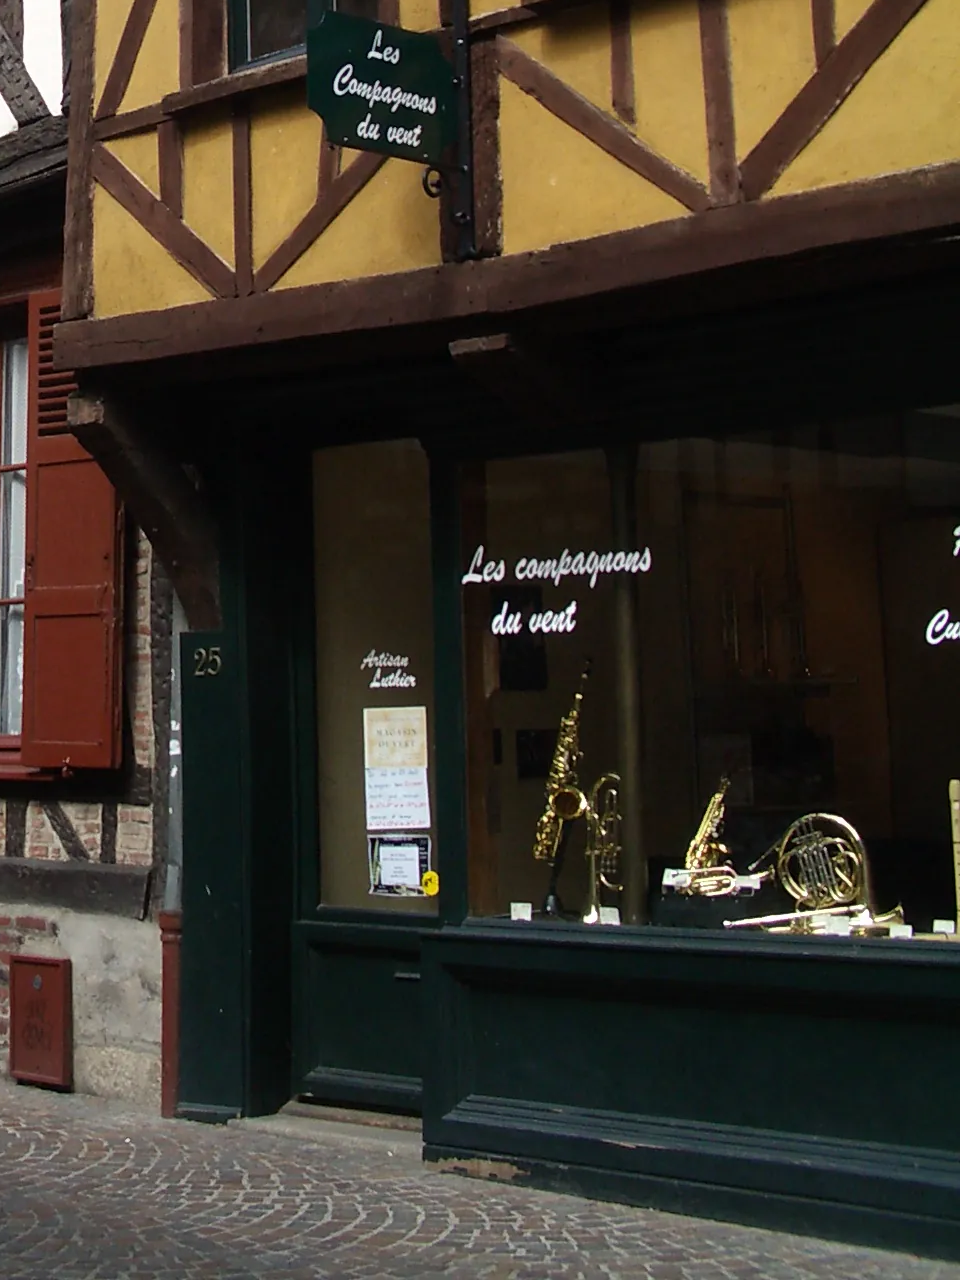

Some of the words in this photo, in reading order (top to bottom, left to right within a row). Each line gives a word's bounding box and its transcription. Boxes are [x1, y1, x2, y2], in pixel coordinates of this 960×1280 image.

[367, 29, 400, 64] Les
[333, 63, 437, 114] Compagnons
[357, 113, 380, 140] du
[387, 124, 423, 148] vent
[461, 544, 506, 585] Les
[515, 546, 652, 589] compagnons
[491, 600, 523, 636] du
[528, 600, 577, 634] vent
[194, 647, 222, 676] 25
[360, 649, 409, 670] Artisan
[369, 668, 417, 688] Luthier
